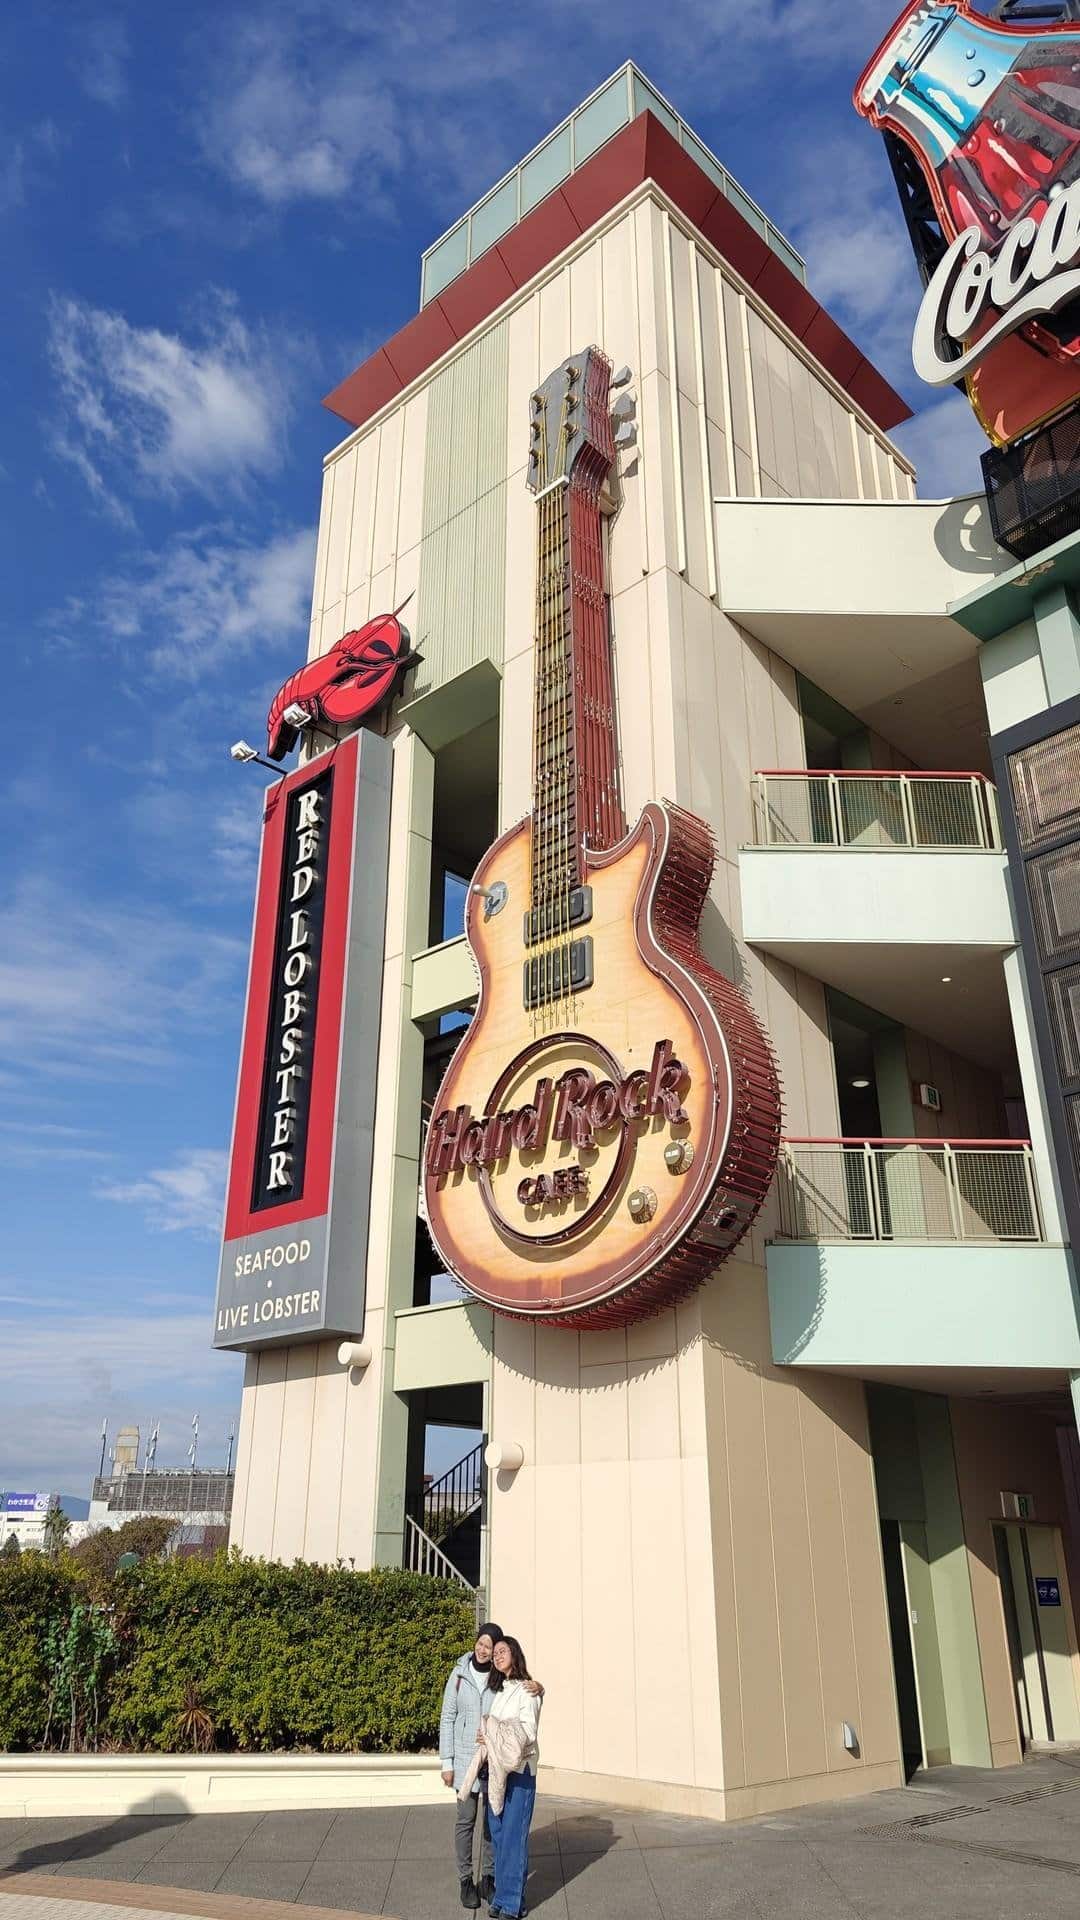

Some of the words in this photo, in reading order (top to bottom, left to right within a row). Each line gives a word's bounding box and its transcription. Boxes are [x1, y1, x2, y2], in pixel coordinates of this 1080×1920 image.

[912, 178, 1080, 384] Coca
[290, 789, 321, 902] RED
[266, 908, 310, 1191] LOBSTER
[426, 1077, 553, 1178] Hard
[554, 1038, 689, 1150] Rock
[217, 1304, 249, 1331] LIVE
[253, 1290, 320, 1323] LOBSTER
[235, 1239, 311, 1277] SEAFOOD
